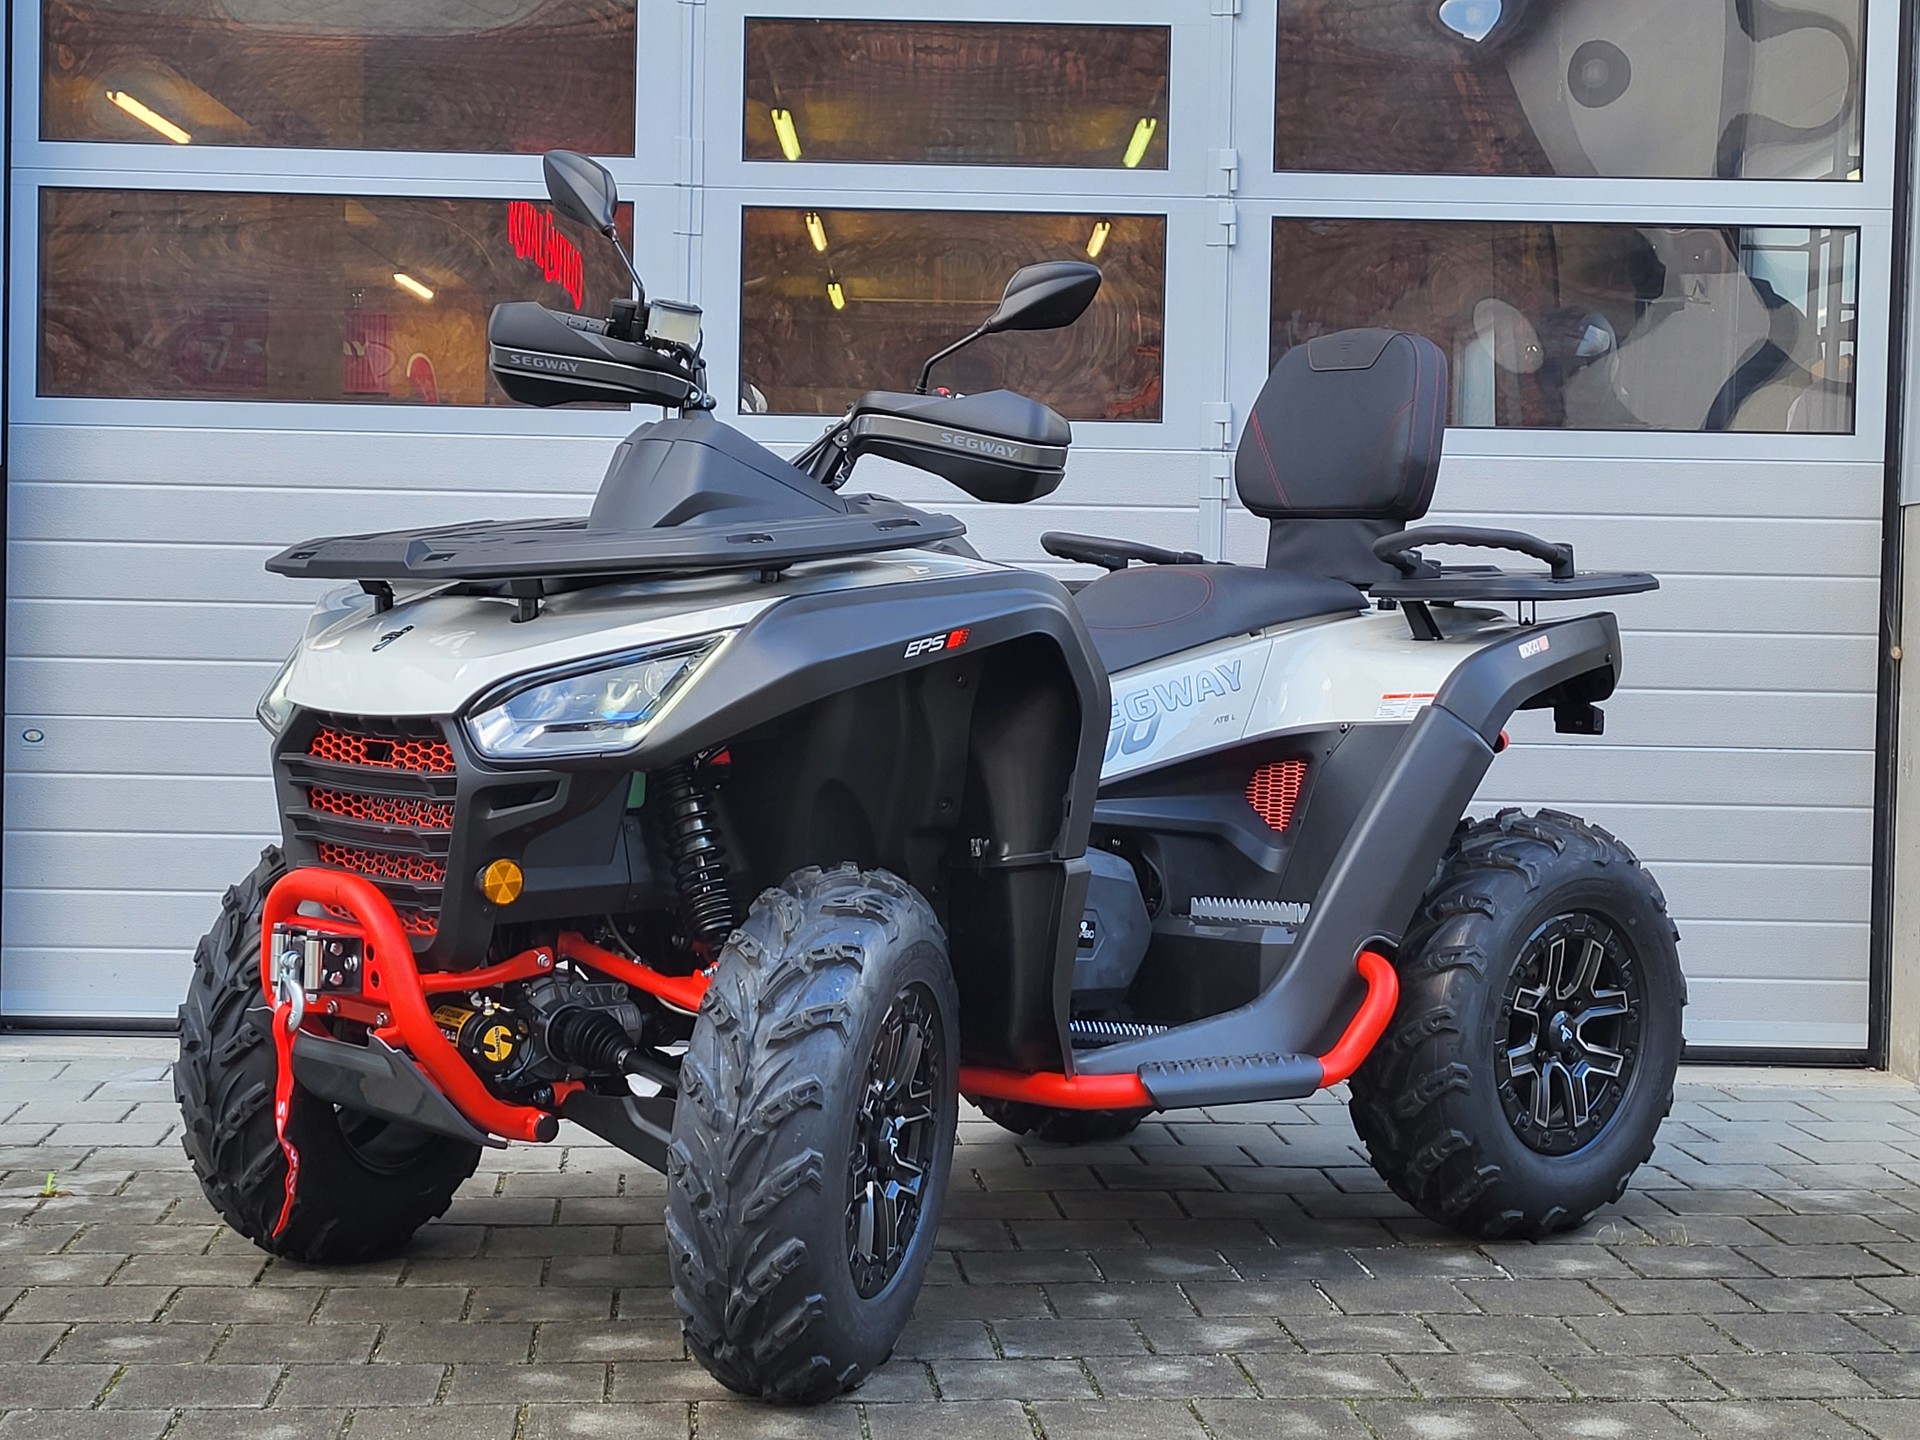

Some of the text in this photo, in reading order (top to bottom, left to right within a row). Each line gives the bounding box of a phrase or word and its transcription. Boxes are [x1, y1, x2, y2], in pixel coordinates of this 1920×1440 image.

[510, 354, 579, 373] SEGWAY
[940, 432, 1018, 458] SEGWAY
[904, 633, 947, 658] EPS
[1110, 659, 1241, 731] EGWAY
